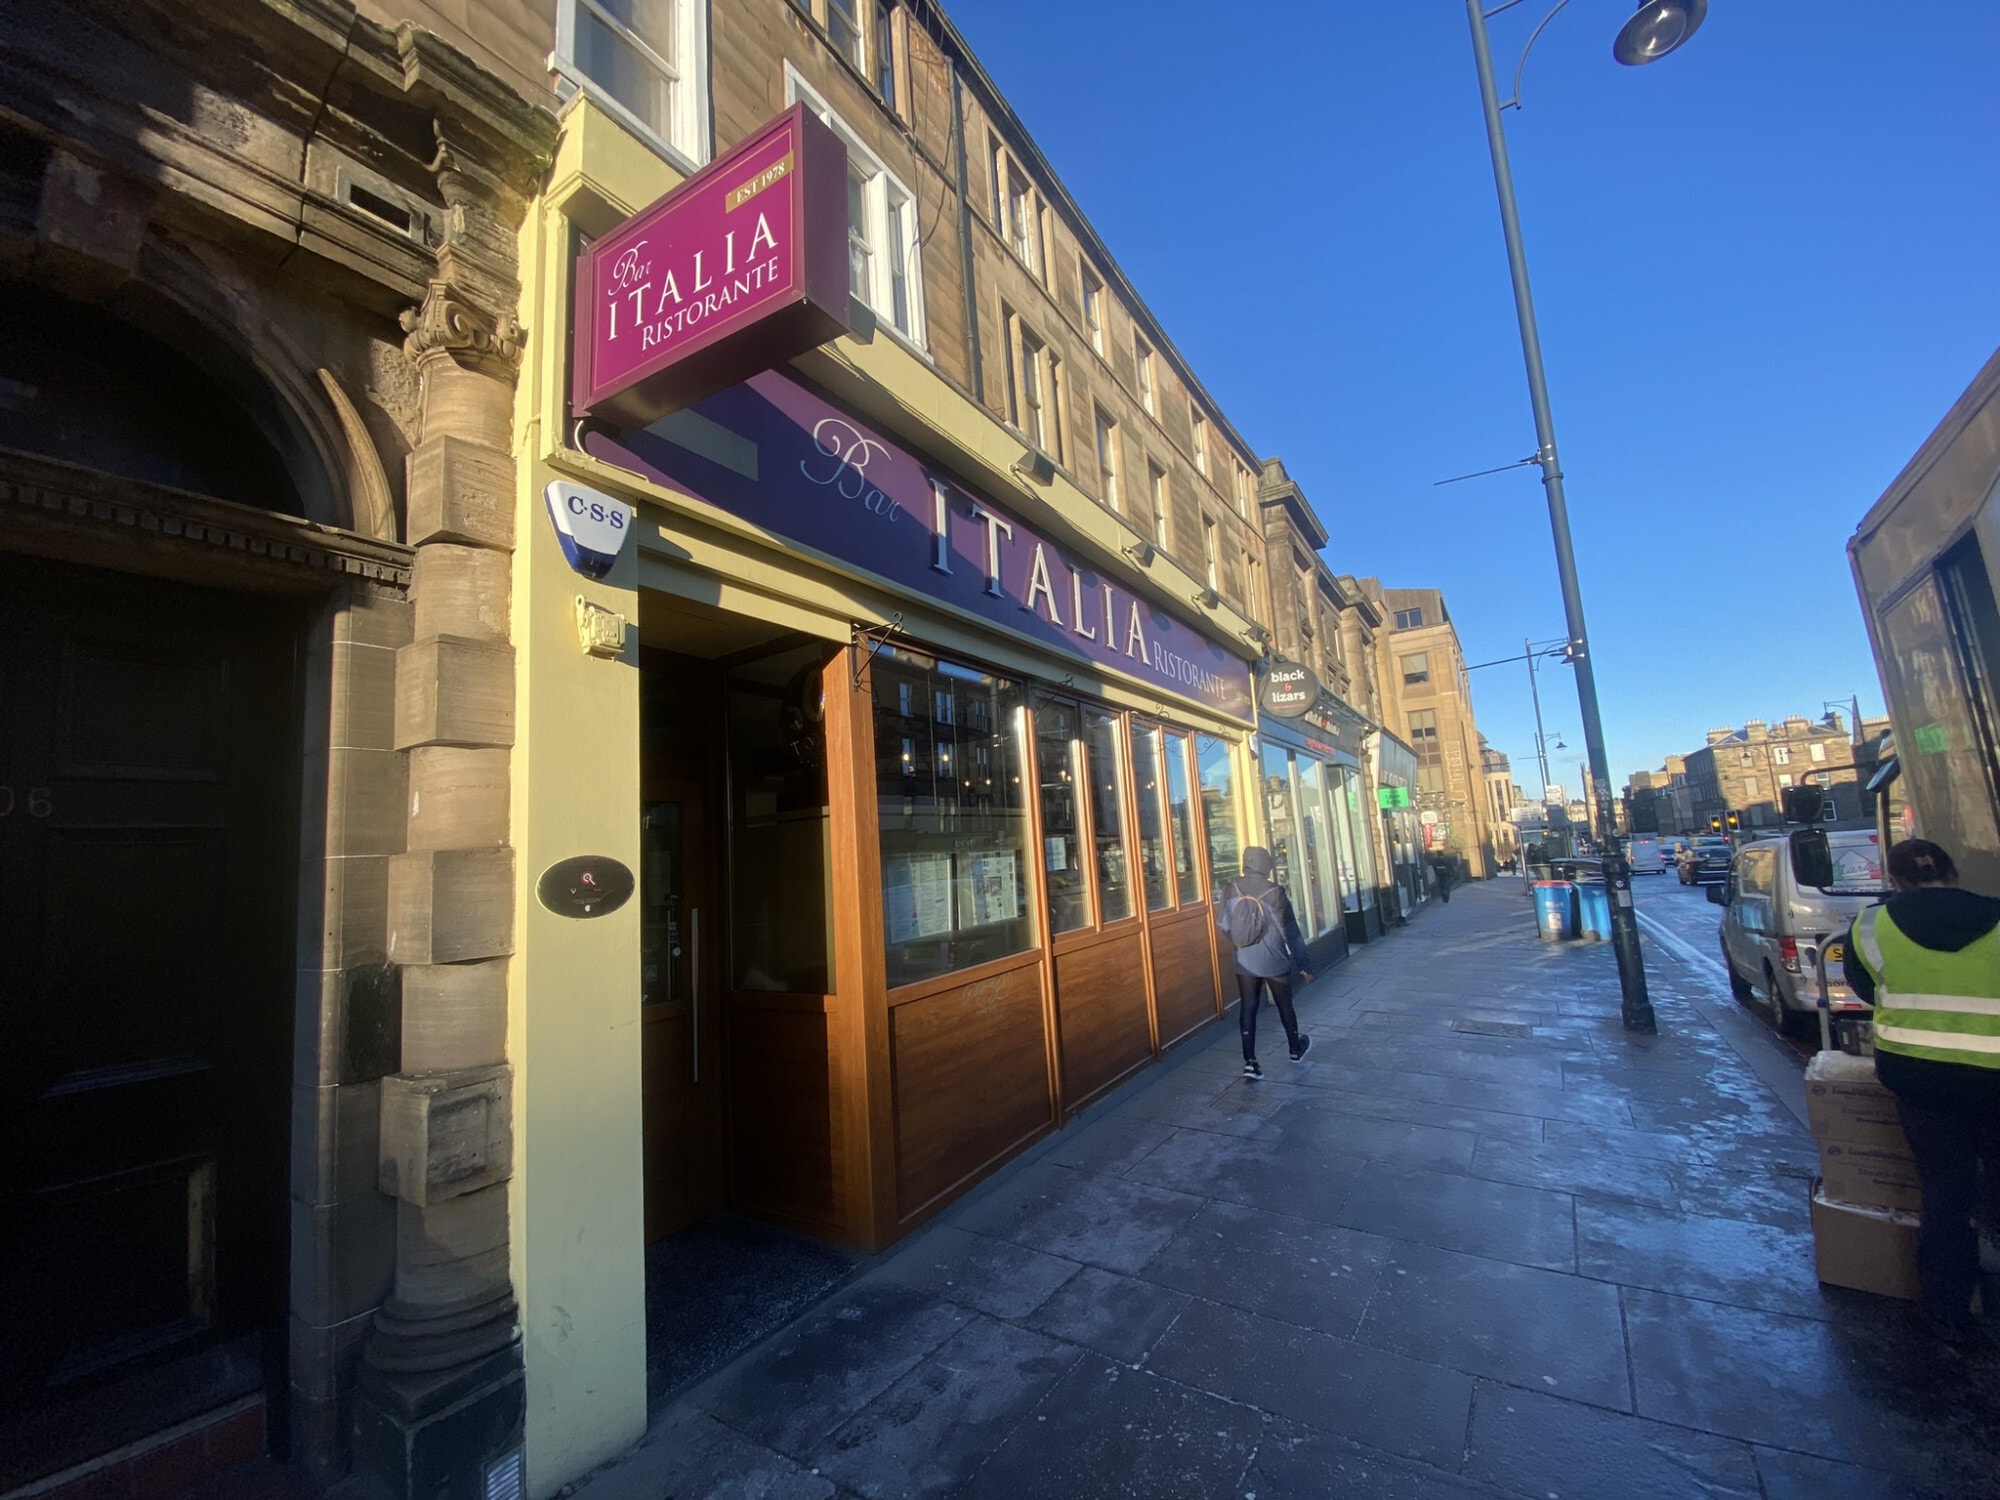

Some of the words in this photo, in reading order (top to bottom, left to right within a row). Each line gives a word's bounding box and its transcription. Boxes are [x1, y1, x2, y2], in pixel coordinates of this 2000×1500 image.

[736, 180, 758, 204] EST
[761, 162, 785, 188] 1978
[607, 240, 653, 297] Bar
[608, 212, 778, 341] ITALIA
[641, 256, 779, 351] RISTORANTE
[800, 418, 900, 524] Bar
[929, 477, 1151, 667] ITALIA
[1153, 641, 1227, 700] RISTORANTE
[1270, 669, 1305, 683] black
[1272, 691, 1306, 703] lizars
